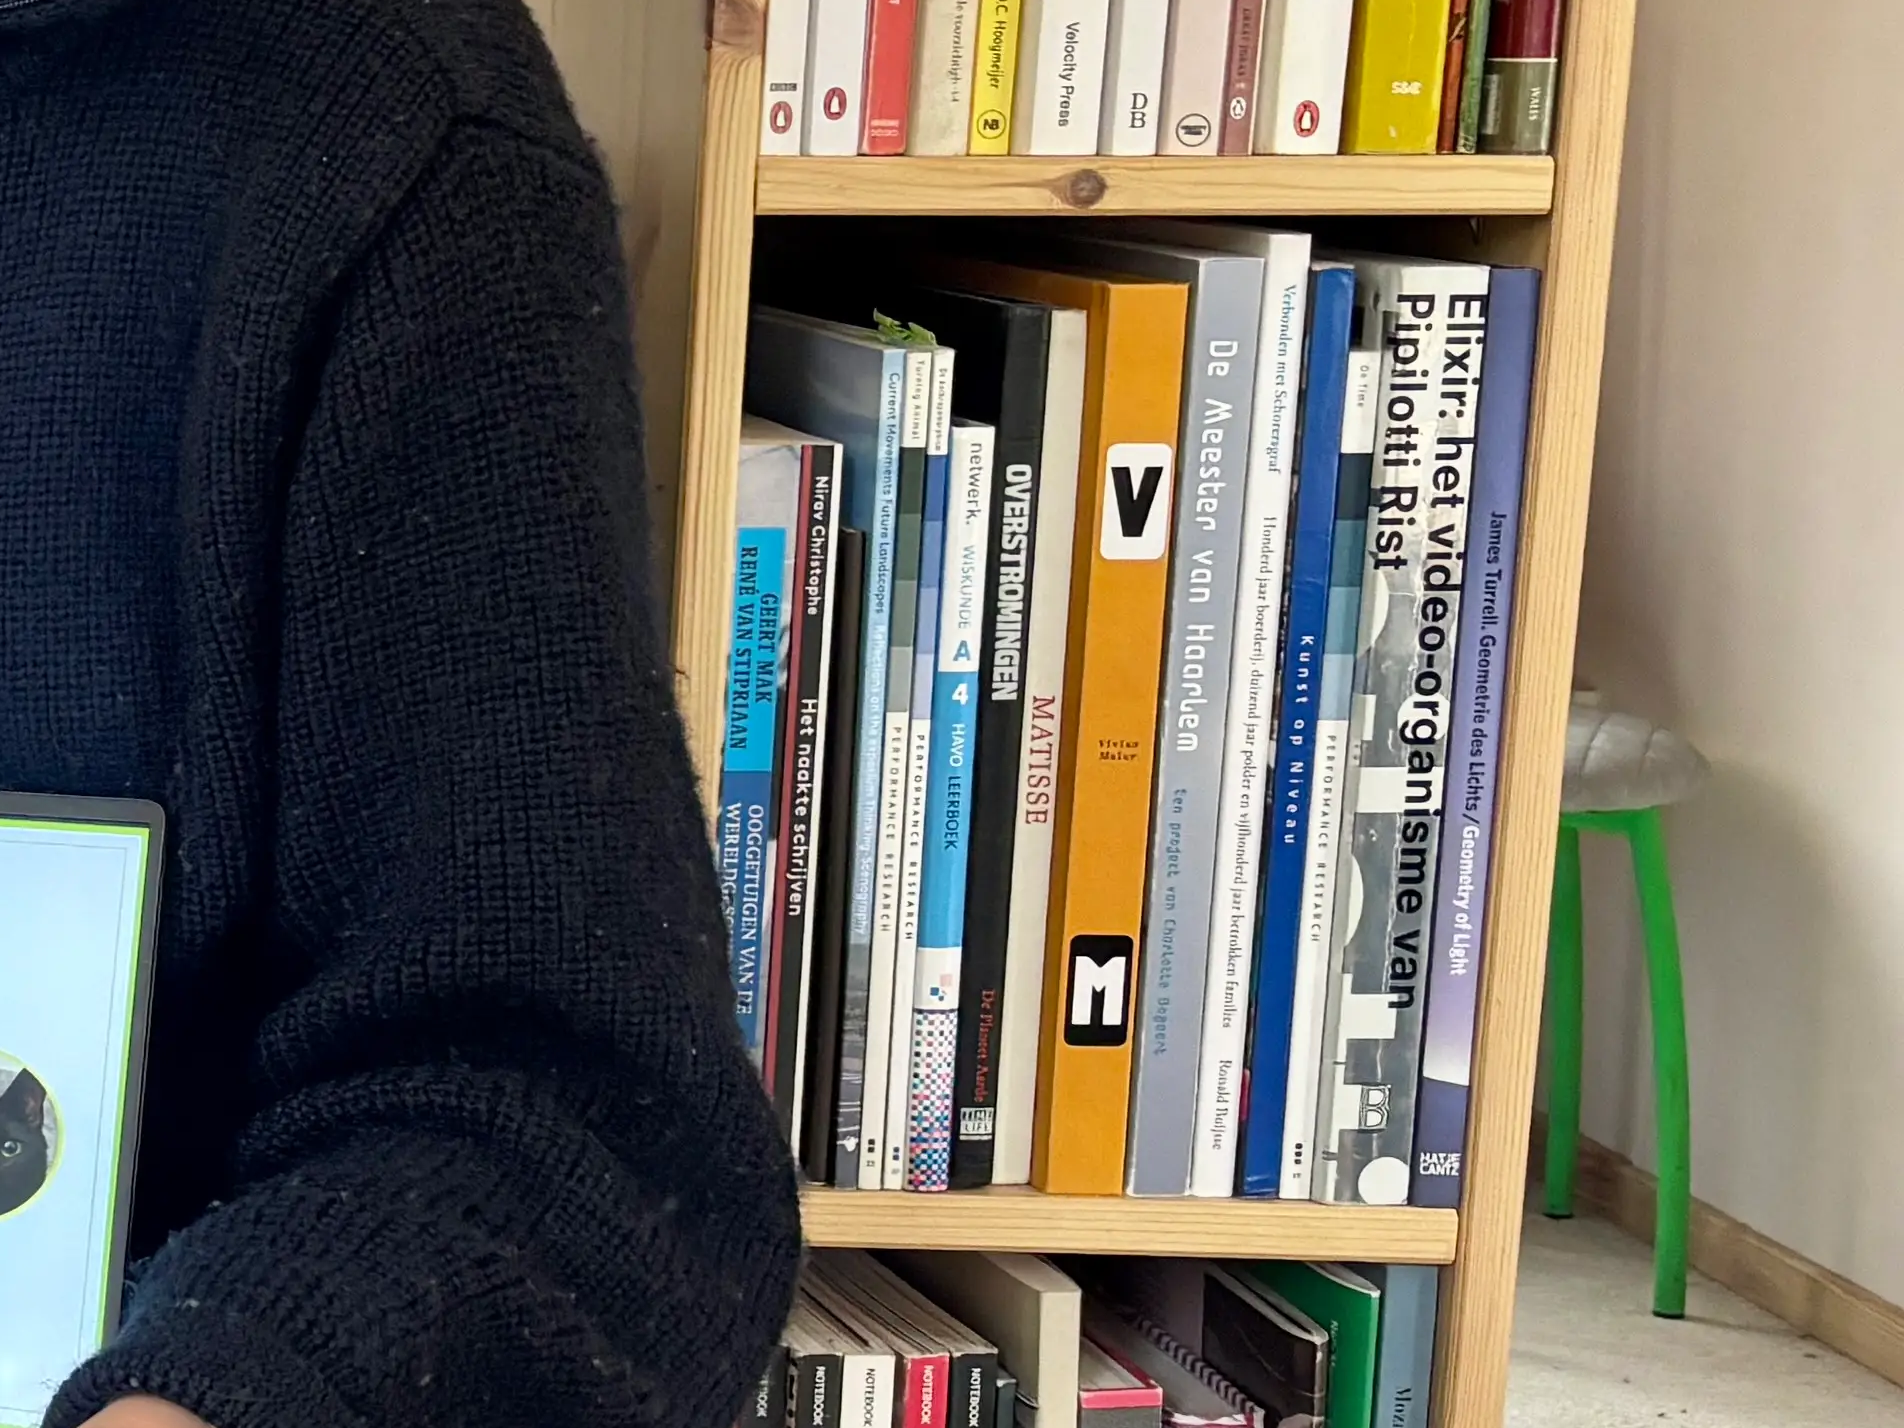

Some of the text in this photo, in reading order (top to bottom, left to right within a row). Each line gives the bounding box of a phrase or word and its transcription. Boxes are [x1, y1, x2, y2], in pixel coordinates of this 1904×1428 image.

[986, 20, 1006, 90] Hooymeijer
[1058, 21, 1081, 81] Velocity
[1058, 85, 1073, 127] Press
[1372, 293, 1438, 571] Pipilotti Rist
[872, 372, 901, 613] Current Movements Future Landscapes
[1110, 466, 1164, 538] V
[1176, 339, 1239, 752] De Meester van Haarlem
[1486, 511, 1507, 564] James
[990, 463, 1033, 701] OVERSTROMINGEN
[1479, 568, 1503, 631] Turrell.
[729, 546, 765, 749] RENÉ VAN STIPRIAAN
[753, 593, 780, 704] GEERT MAK
[943, 442, 984, 850] netwerk. WISKUNDE A 4 HAVO LEERBOEK
[1387, 293, 1487, 1011] Elixir: het video-organisme van
[1472, 635, 1497, 723] Geometrie
[786, 476, 830, 916] Nirav Christophe Het naakte schrijven
[1023, 695, 1057, 825] MATISSE
[1283, 635, 1315, 843] Kunst op Niveau
[1469, 727, 1489, 757] des
[1464, 761, 1486, 811] Lichts
[738, 804, 765, 942] OOGGETUIGEN
[1447, 932, 1469, 976] Light
[1453, 912, 1473, 930] of
[737, 946, 758, 984] VAN
[1072, 955, 1127, 1027] M
[1420, 1152, 1461, 1164] HATJE
[1420, 1163, 1459, 1176] CANTZ
[811, 1366, 826, 1426] NOTEBOOK
[861, 1367, 876, 1427] NOTEBOOK
[919, 1365, 934, 1425] NOTEBOOK
[967, 1367, 982, 1427] NOTEBOOK
